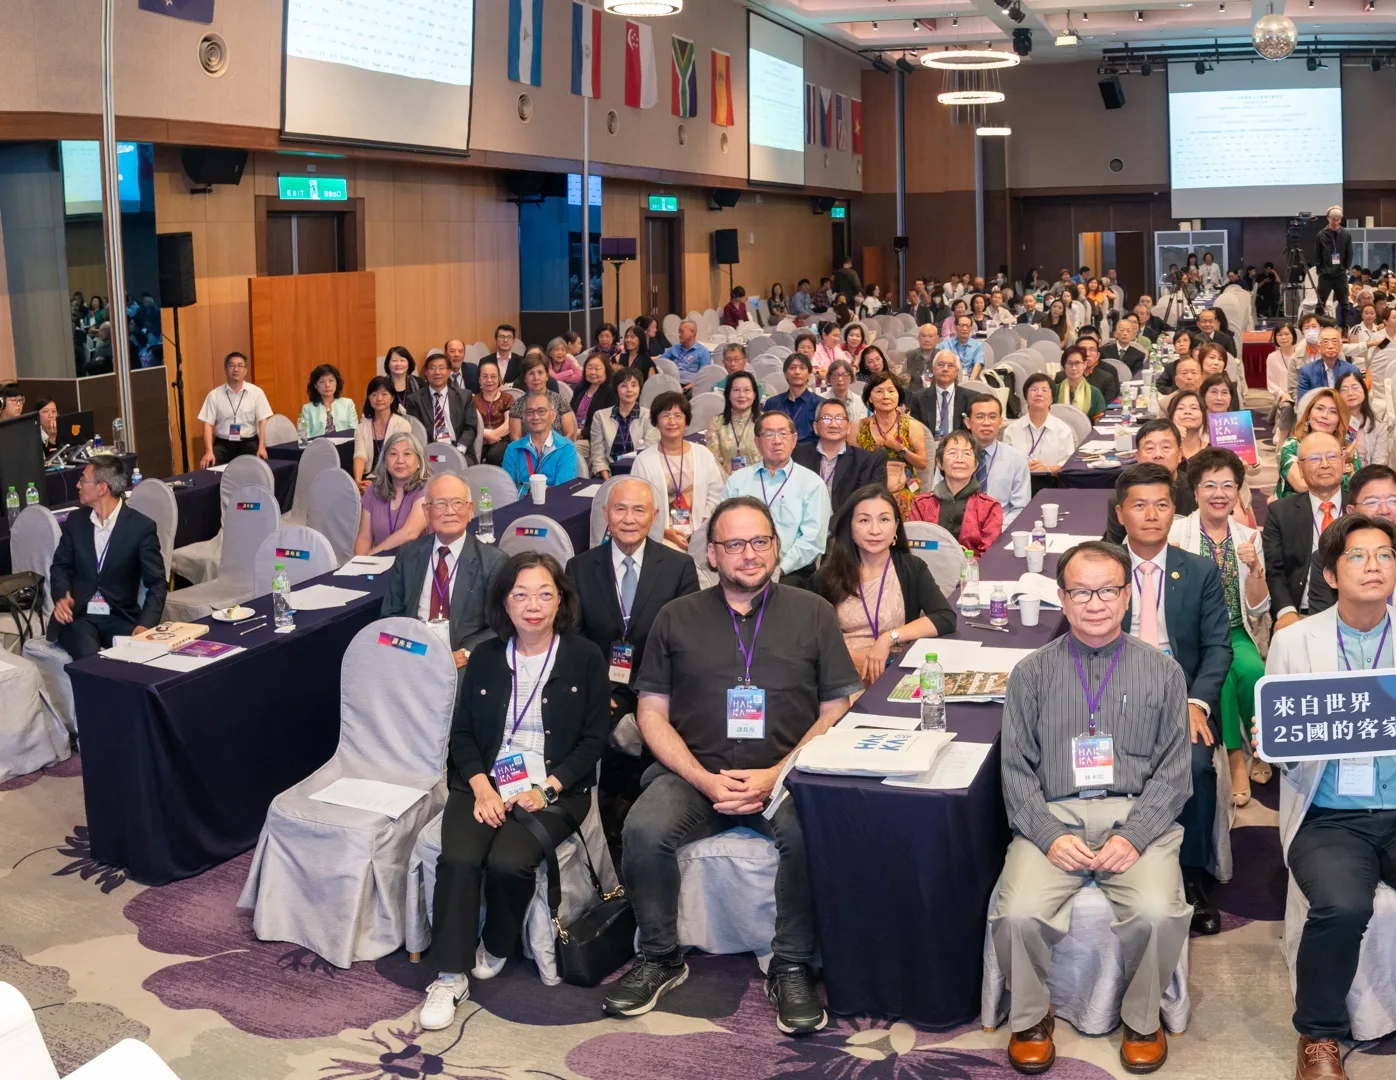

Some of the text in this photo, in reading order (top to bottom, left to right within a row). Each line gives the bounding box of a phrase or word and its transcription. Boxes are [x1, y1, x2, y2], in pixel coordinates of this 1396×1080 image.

[286, 189, 304, 197] EXIT
[1214, 416, 1239, 427] HAK
[1216, 426, 1231, 436] KA
[733, 700, 753, 709] HAK
[1273, 691, 1372, 718] 來自世界
[732, 708, 746, 717] KA
[854, 733, 889, 750] HAK
[878, 738, 908, 751] KA
[1078, 747, 1100, 757] HAK
[1079, 756, 1093, 766] KA
[497, 763, 516, 776] HAK
[499, 774, 512, 783] KA
